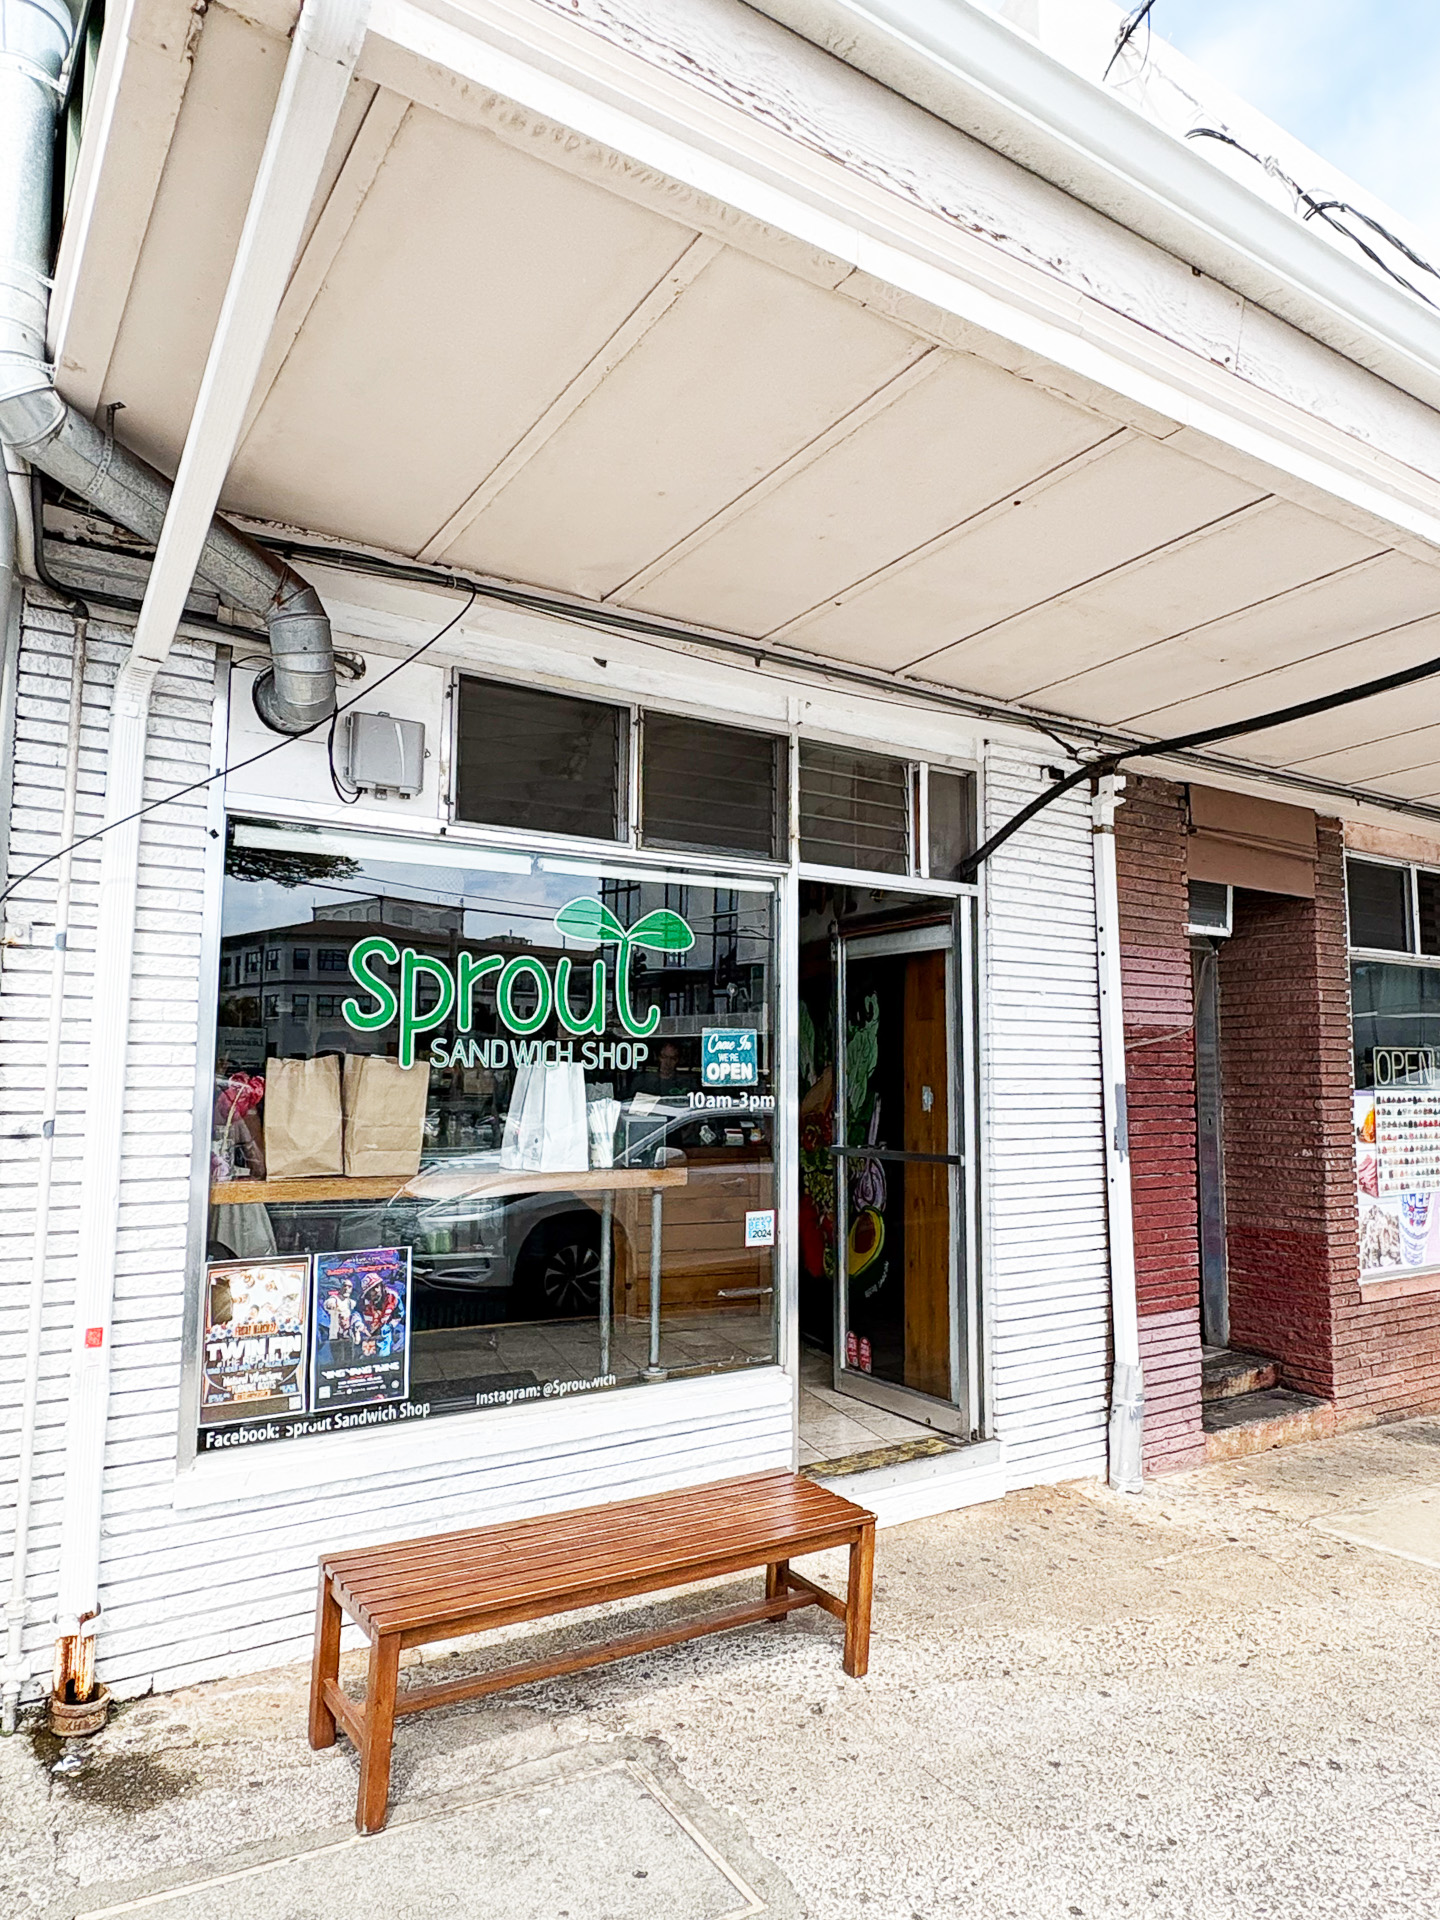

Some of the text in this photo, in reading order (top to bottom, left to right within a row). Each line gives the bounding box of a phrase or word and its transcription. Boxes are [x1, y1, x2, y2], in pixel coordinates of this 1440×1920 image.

[342, 932, 662, 1070] Sprout
[429, 1037, 649, 1070] SANDWICH SHOP
[707, 1033, 752, 1054] Come In
[706, 1062, 753, 1081] OPEN
[1376, 1051, 1433, 1085] OPEN
[687, 1091, 775, 1112] 10am-3pm
[752, 1229, 772, 1238] 2024
[207, 1338, 266, 1361] TWIN
[475, 1385, 541, 1406] Instagram:
[205, 1422, 280, 1449] Facebook:
[334, 1404, 397, 1429] Sandwich
[399, 1401, 431, 1419] Shop
